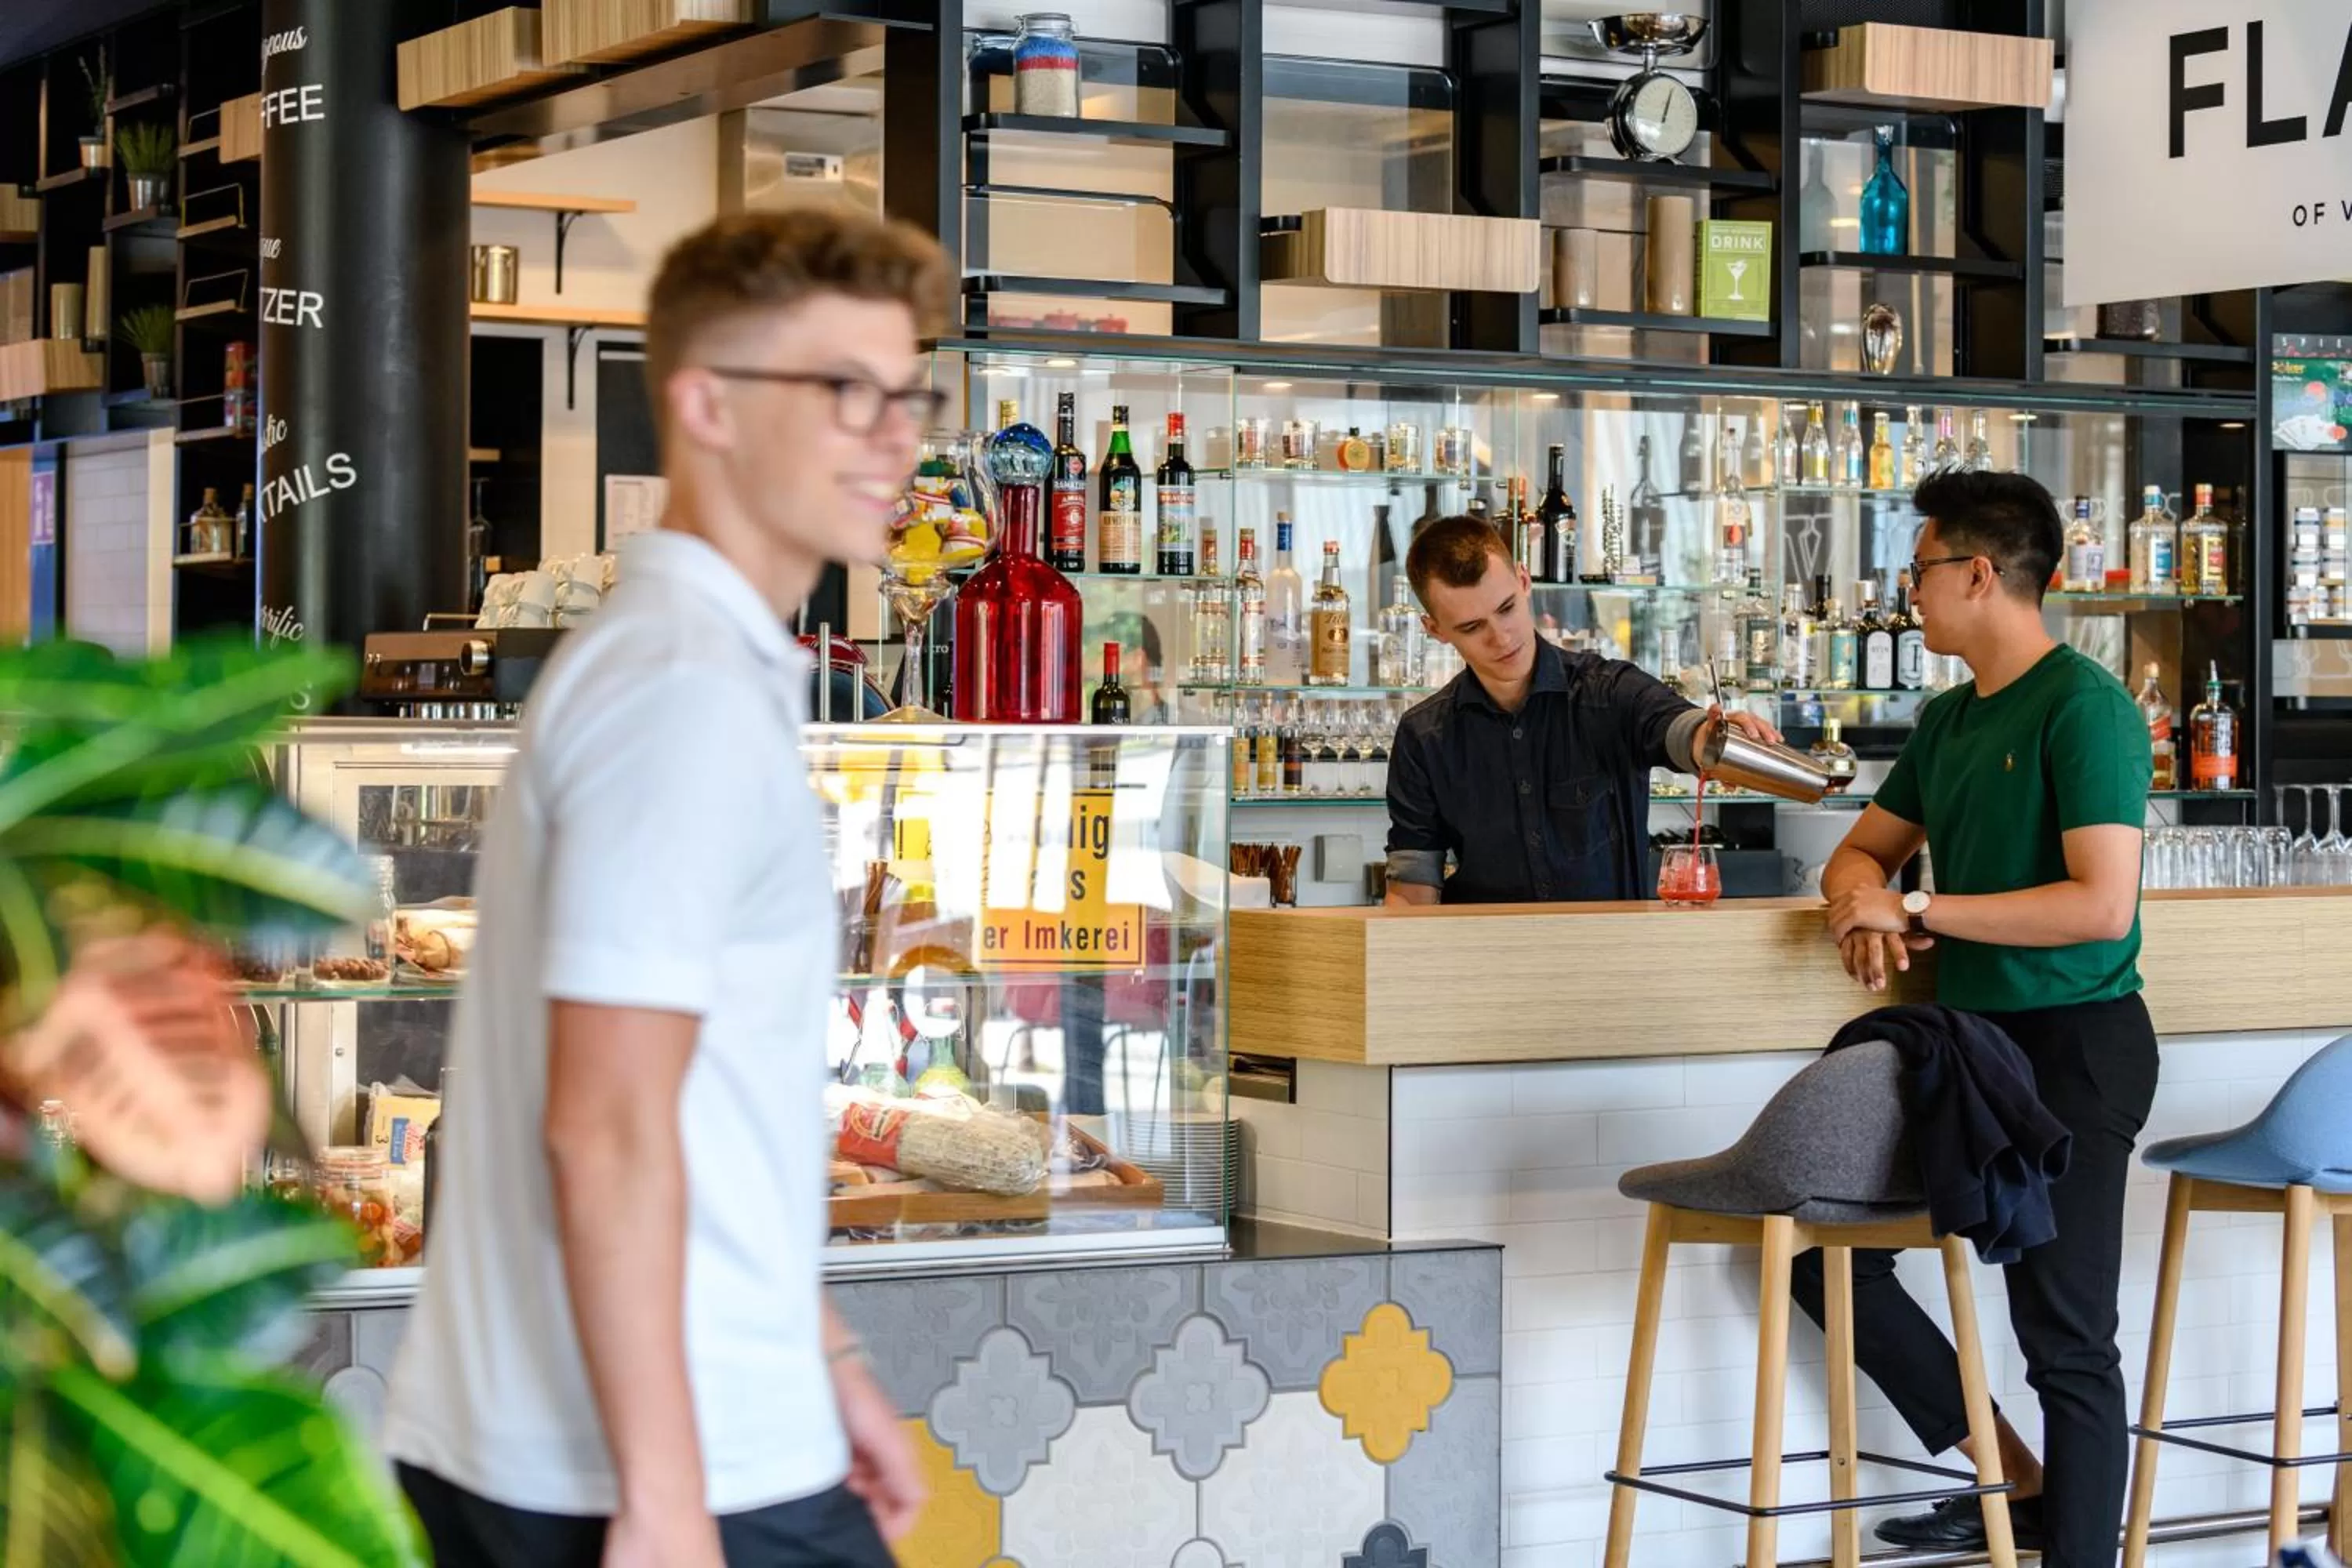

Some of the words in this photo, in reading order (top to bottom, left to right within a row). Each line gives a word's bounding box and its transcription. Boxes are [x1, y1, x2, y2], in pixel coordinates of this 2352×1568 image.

[2292, 202, 2325, 227] OF
[1711, 235, 1764, 249] DRINK
[1025, 920, 1129, 951] Imkerei
